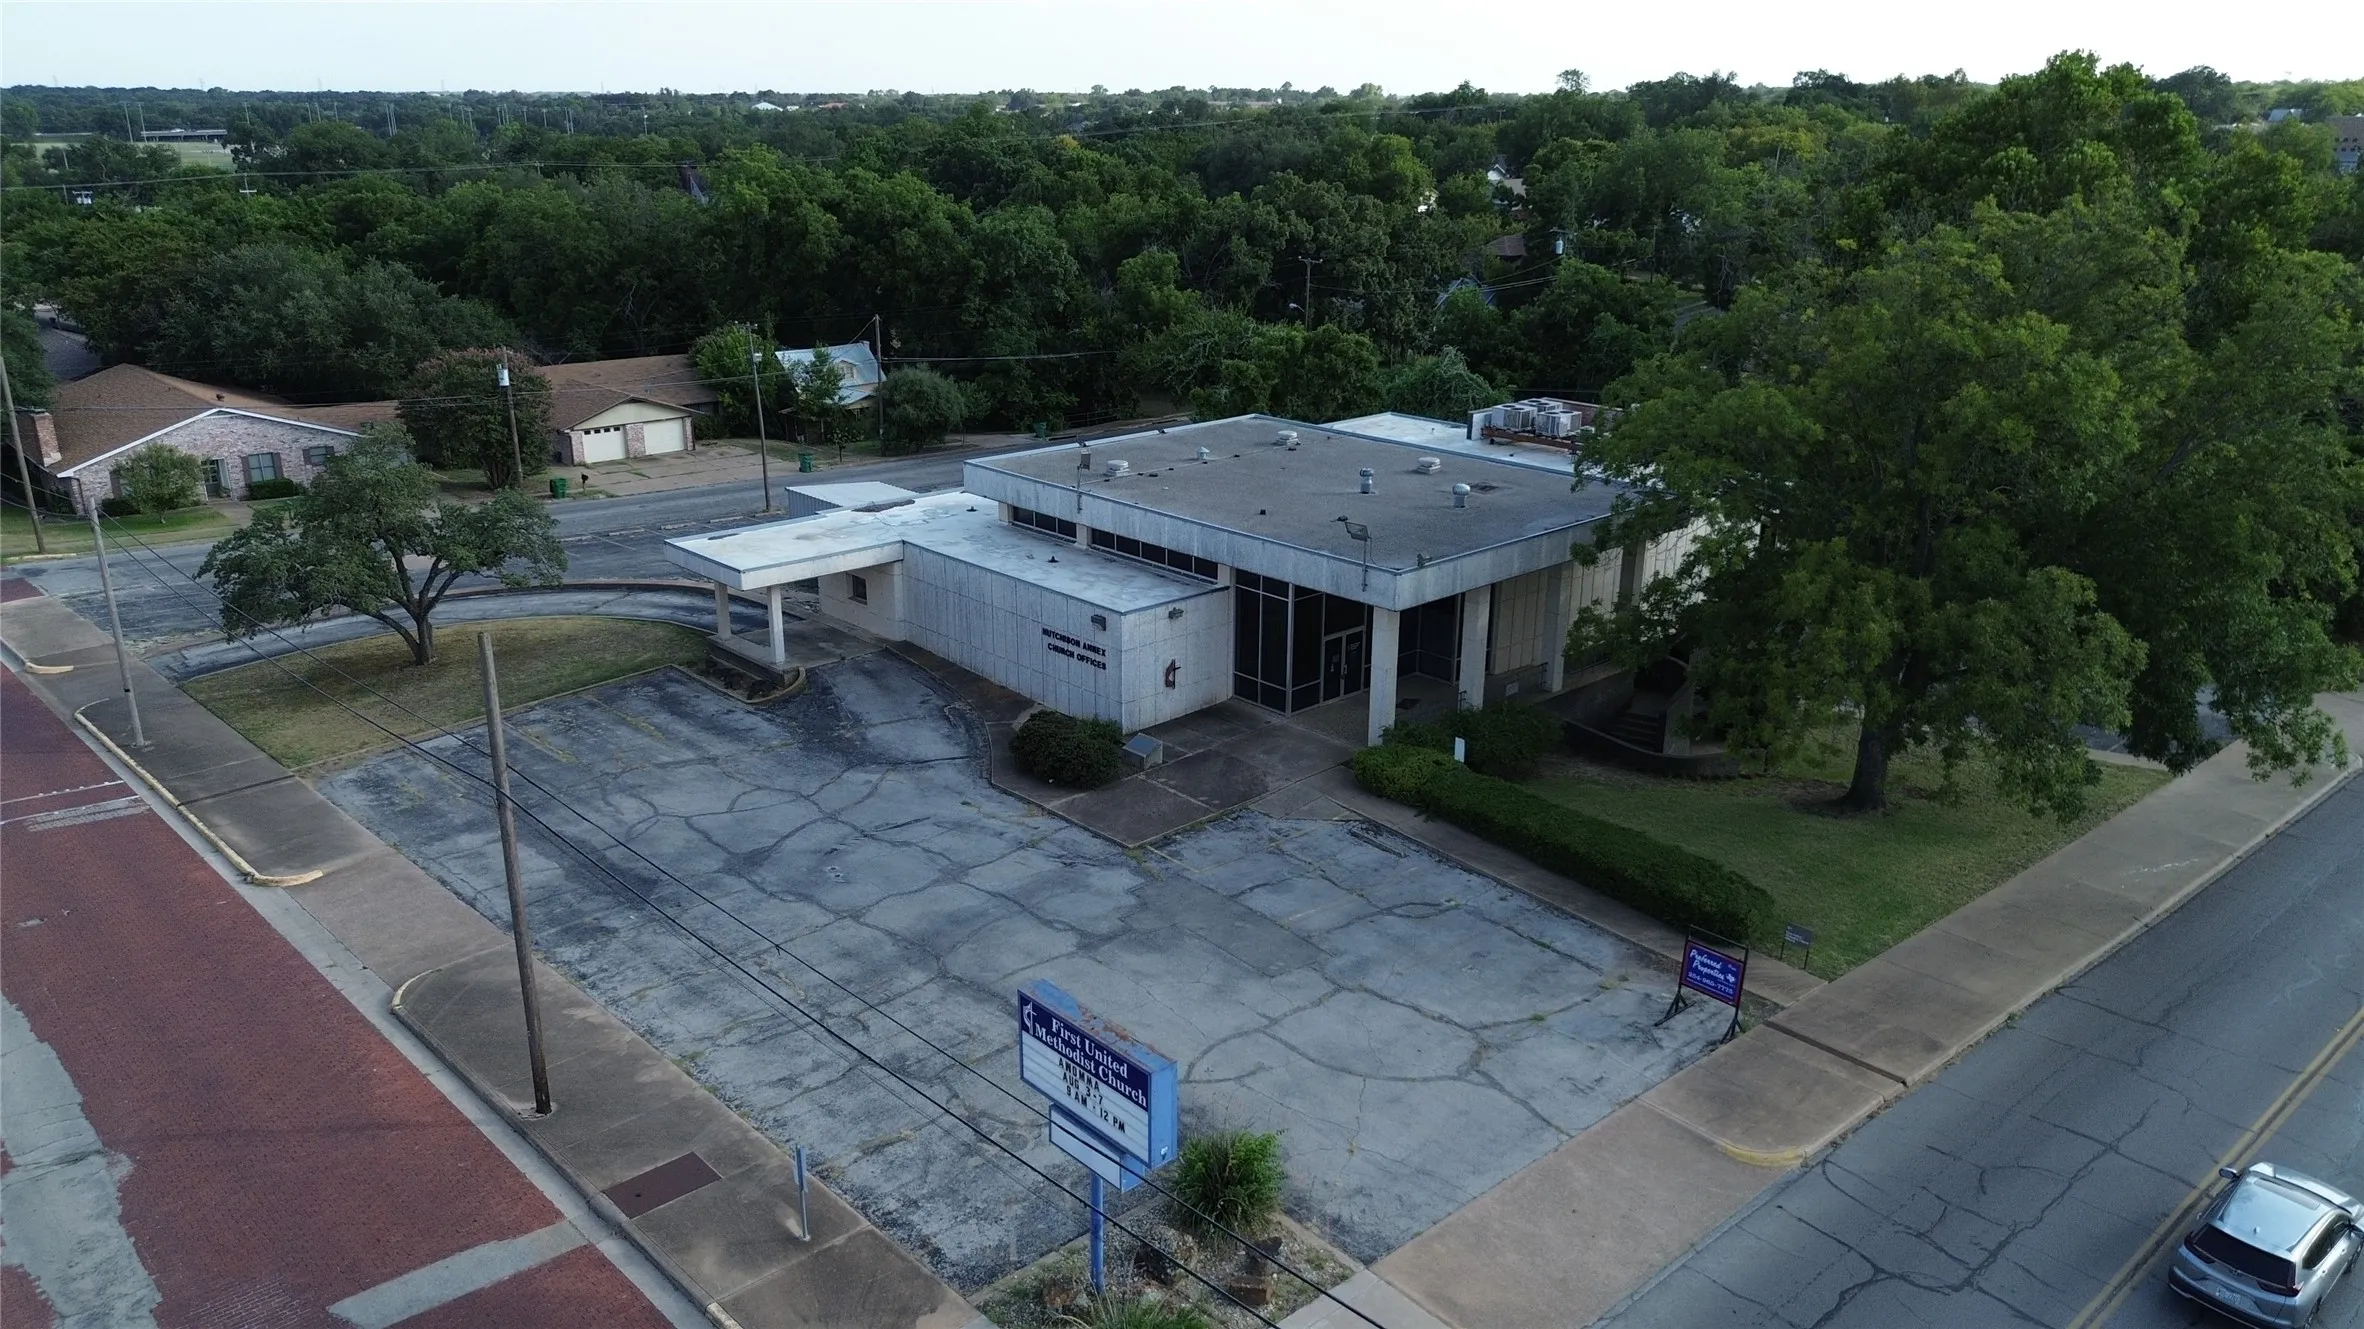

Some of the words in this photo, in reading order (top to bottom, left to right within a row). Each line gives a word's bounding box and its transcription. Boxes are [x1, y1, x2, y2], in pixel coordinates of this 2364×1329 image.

[1047, 642, 1075, 659] CHURCH
[1076, 653, 1107, 670] OFFICES
[1082, 642, 1106, 657] ANNEX
[1689, 949, 1722, 969] Preferred
[1692, 959, 1725, 980] Properties
[1051, 1017, 1081, 1048] First
[1085, 1039, 1128, 1079] United
[1034, 1021, 1096, 1074] Methodist
[1098, 1065, 1147, 1108] Church
[1063, 1072, 1079, 1090] AUG
[1066, 1085, 1072, 1096] 9
[1074, 1091, 1087, 1108] AM
[1099, 1107, 1109, 1122] 12
[1113, 1116, 1126, 1133] PM
